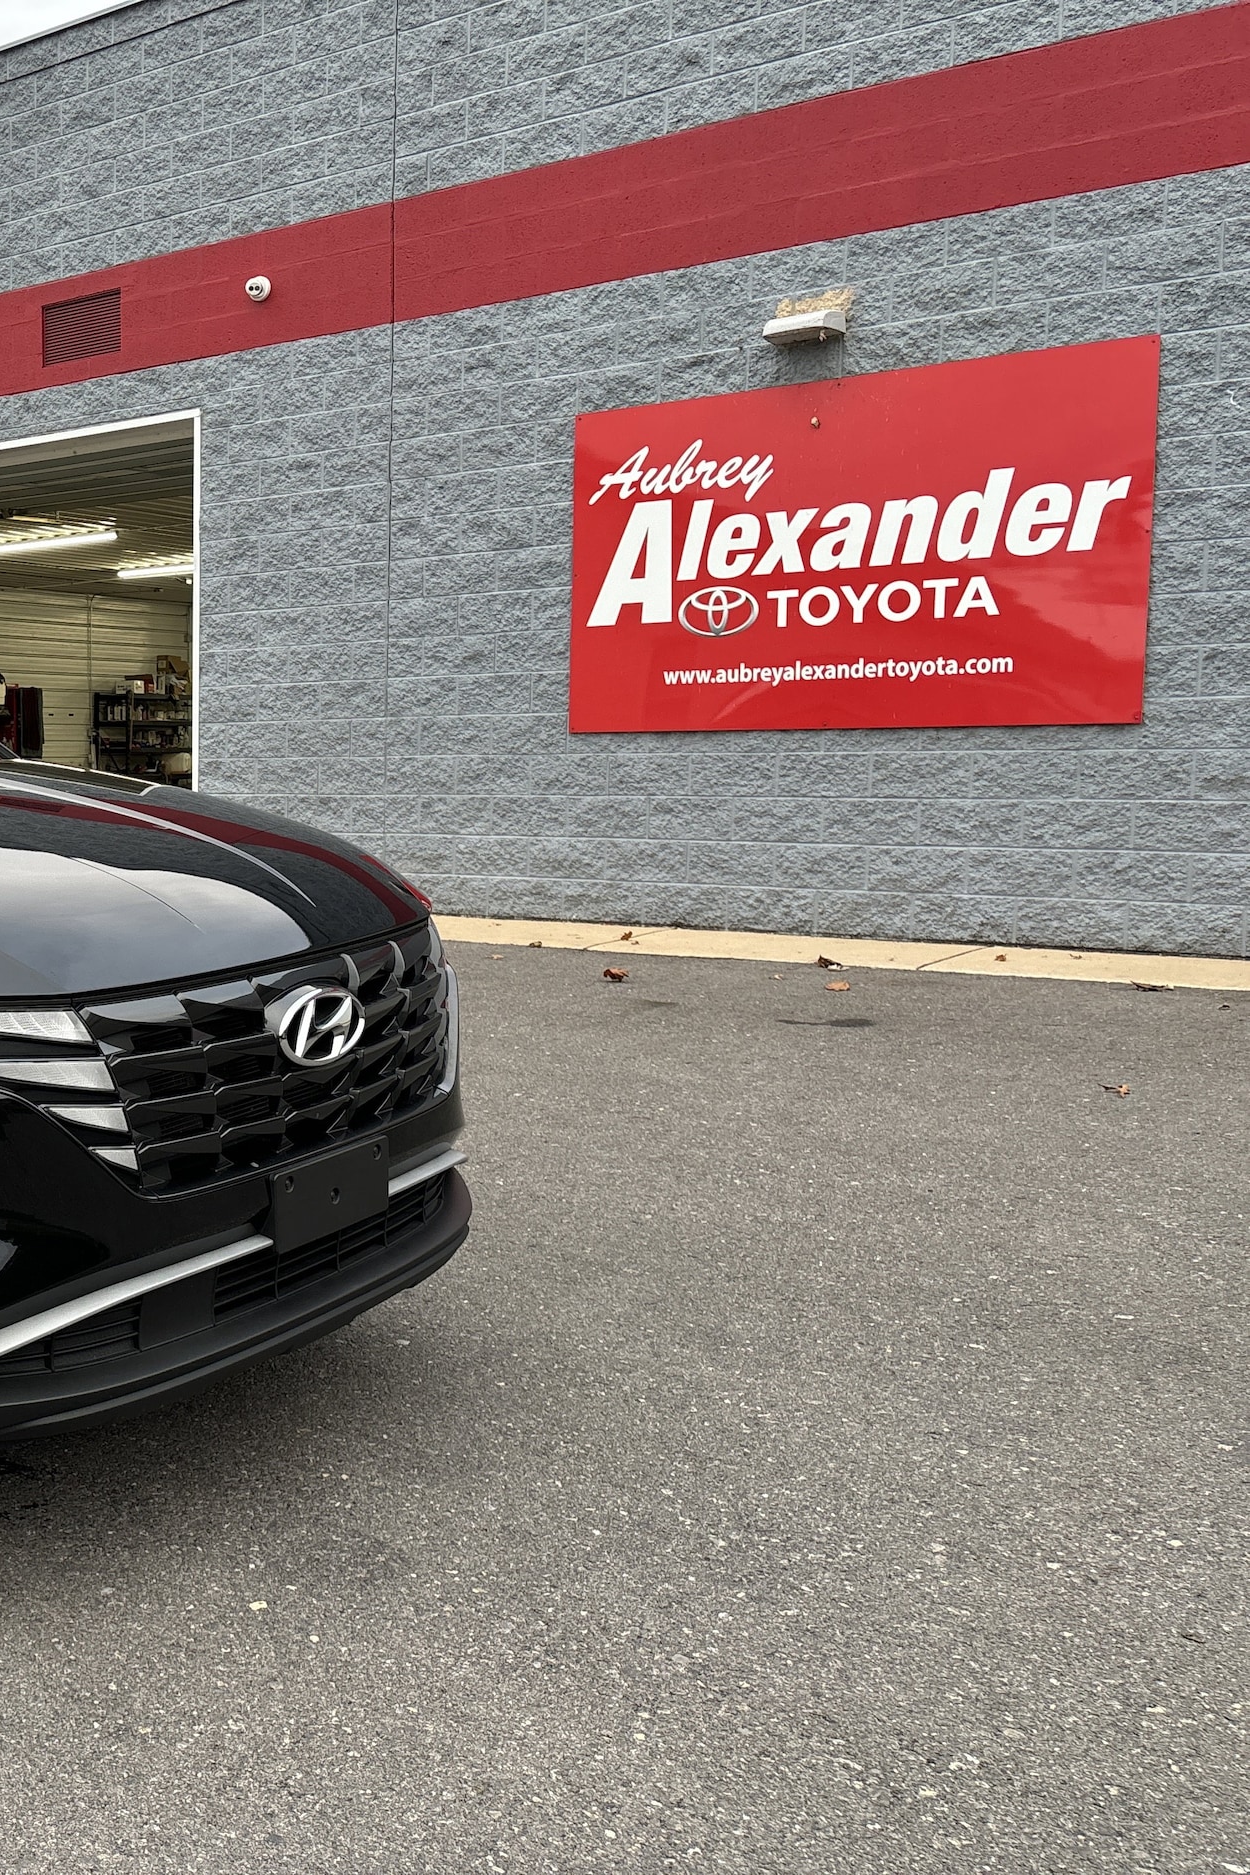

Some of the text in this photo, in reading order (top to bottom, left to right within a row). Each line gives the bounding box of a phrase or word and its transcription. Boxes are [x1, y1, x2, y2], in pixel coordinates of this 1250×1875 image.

[588, 438, 774, 506] Aubrey
[586, 466, 1132, 628] Alexander
[766, 575, 1000, 628] TOYOTA
[662, 655, 1015, 687] www.aubreyalexandertoyota.com
